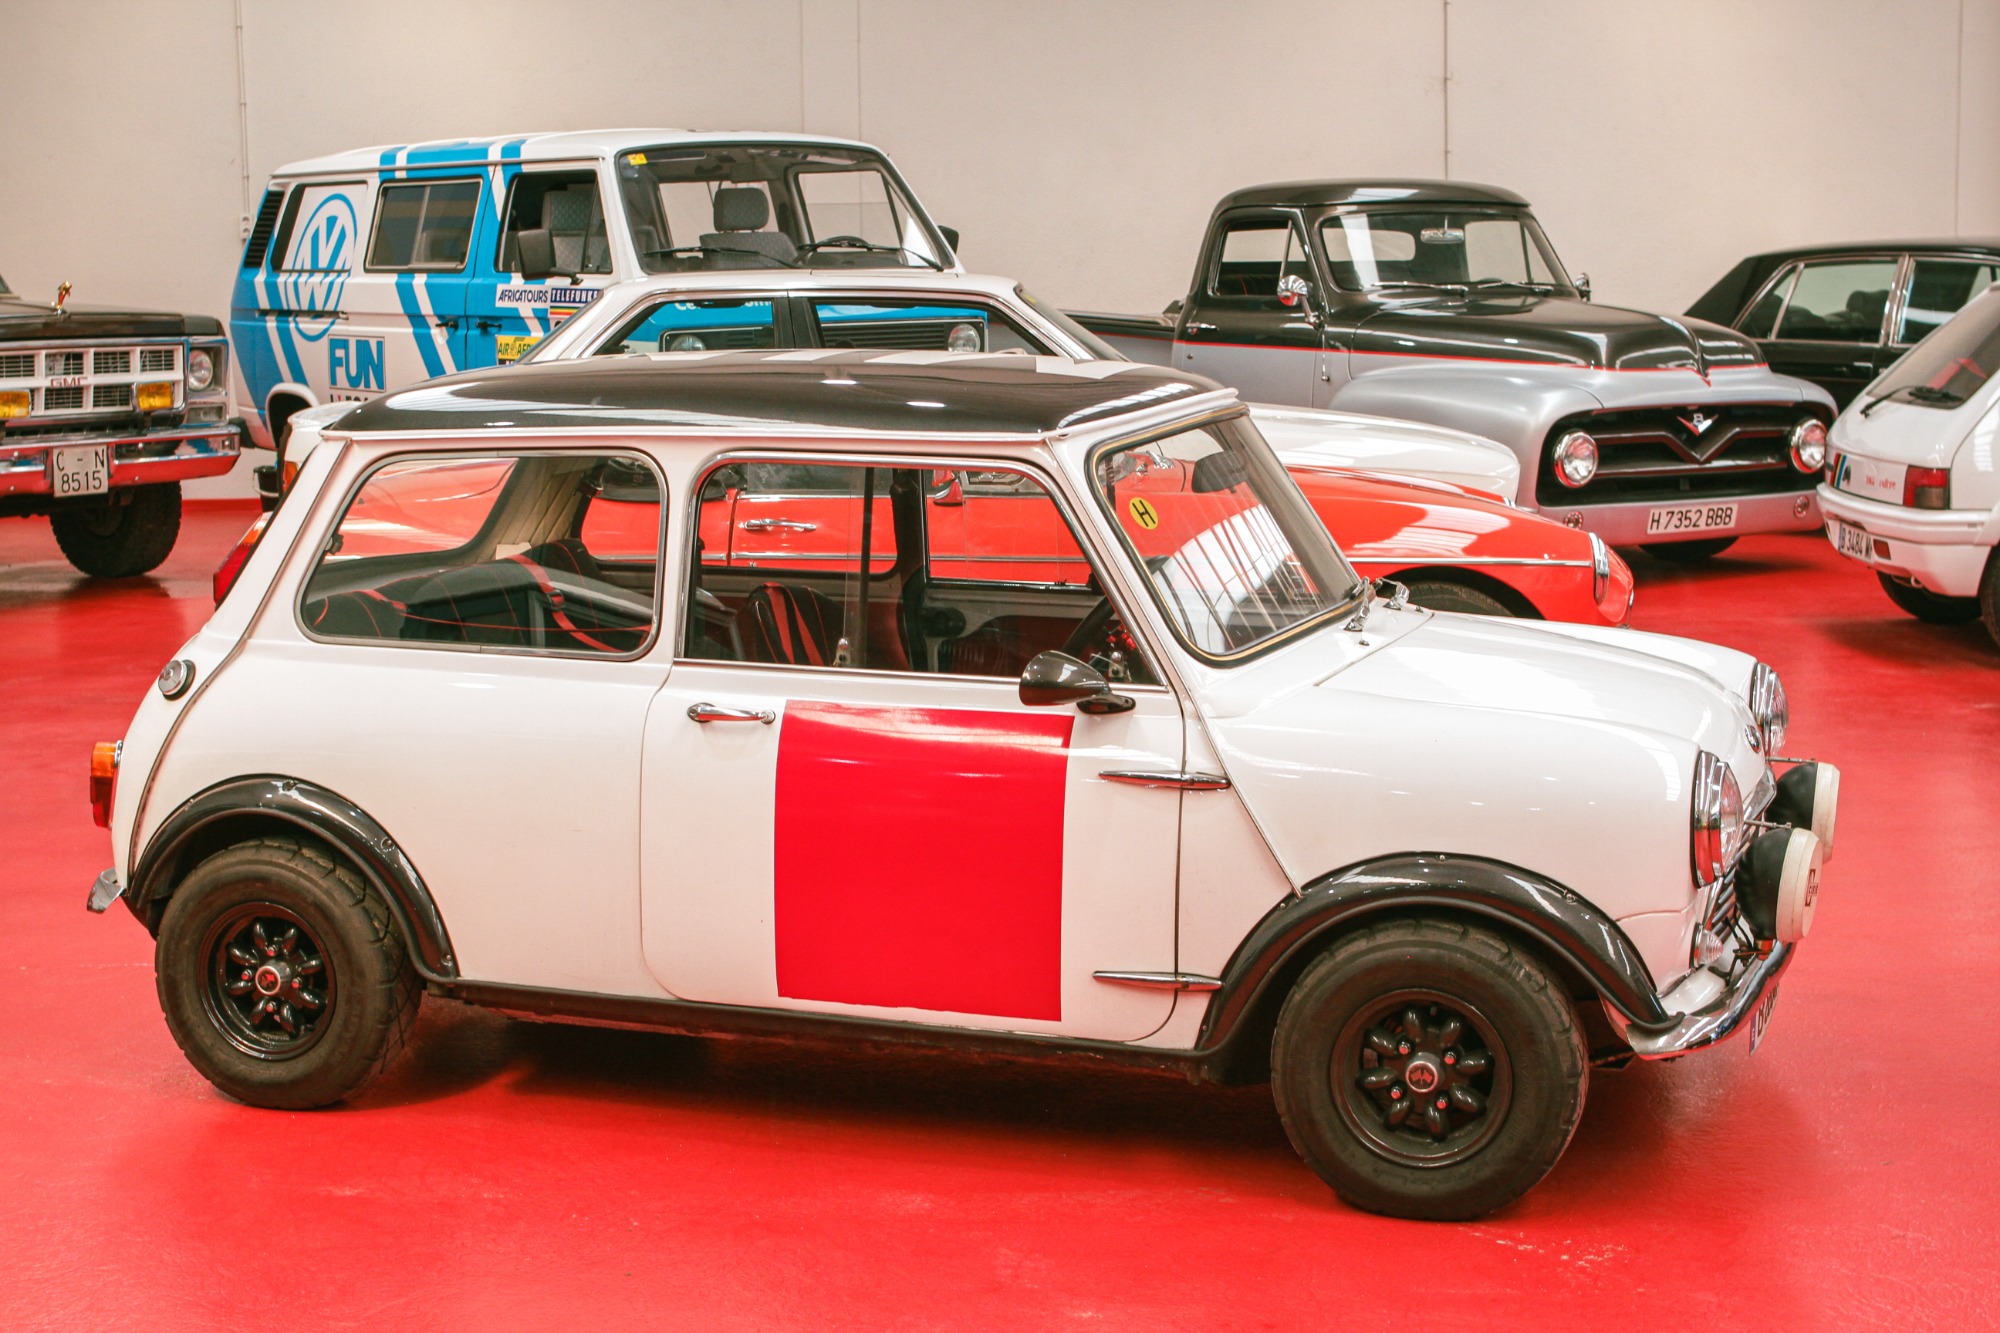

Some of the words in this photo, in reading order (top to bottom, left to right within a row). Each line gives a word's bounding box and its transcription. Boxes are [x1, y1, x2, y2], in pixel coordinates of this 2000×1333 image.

[498, 288, 549, 303] AFRICATOURS
[551, 288, 599, 302] TELEFUNKE
[498, 342, 510, 356] AIR
[329, 337, 385, 390] FUN
[50, 376, 88, 389] GMC
[61, 470, 102, 493] 8515
[1131, 499, 1157, 528] H
[1649, 511, 1662, 531] H
[1664, 509, 1703, 530] 7352
[1705, 506, 1733, 527] BBB
